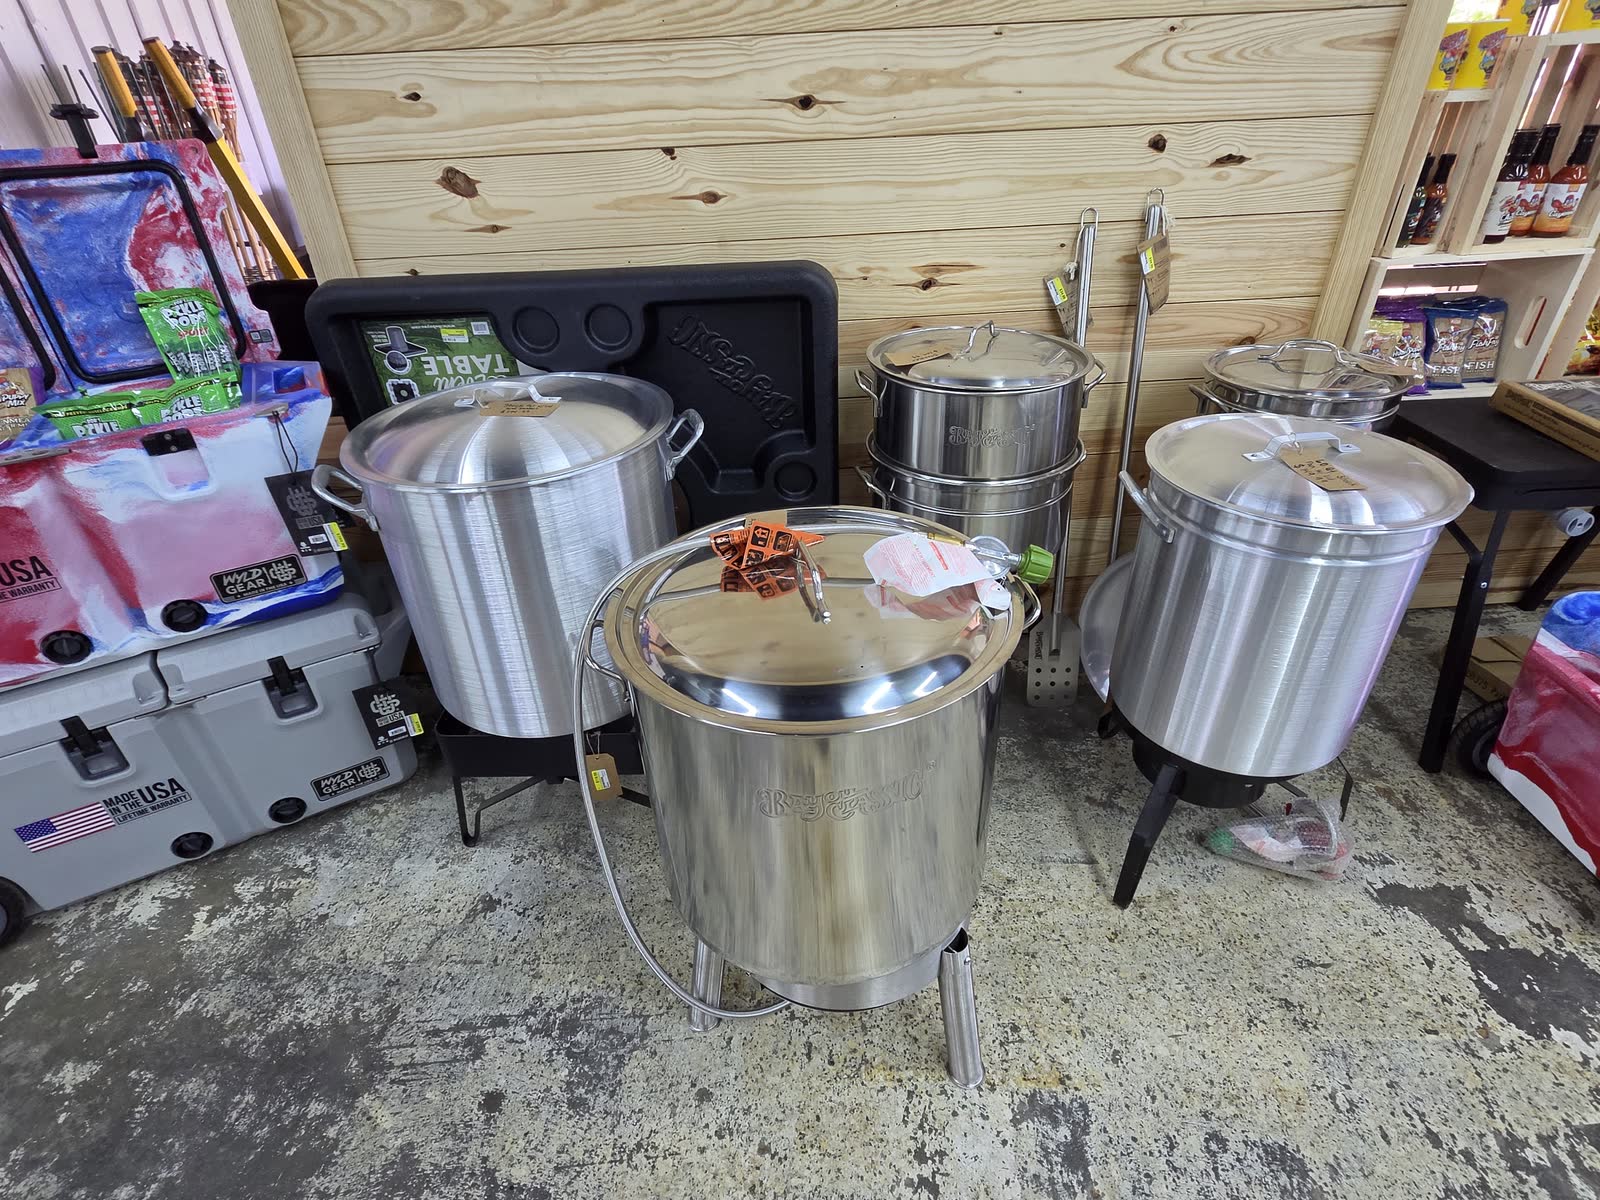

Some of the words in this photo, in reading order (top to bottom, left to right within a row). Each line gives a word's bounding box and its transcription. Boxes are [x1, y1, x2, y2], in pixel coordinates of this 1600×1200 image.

[177, 326, 209, 340] SPORT
[421, 353, 511, 376] TABLE
[1467, 361, 1495, 370] FISH
[2, 393, 31, 402] PUPPY
[7, 399, 26, 408] MIX
[0, 556, 53, 587] USA
[223, 568, 263, 587] WYLD
[8, 580, 56, 597] WARRANTY
[225, 578, 267, 595] GEAR
[321, 771, 353, 788] WYLD
[322, 778, 356, 794] GEAR
[103, 790, 138, 809] MADE
[137, 777, 187, 803] USA
[108, 807, 121, 816] IN
[123, 800, 143, 812] THE
[117, 809, 149, 824] LIFETIME
[150, 794, 189, 812] WARRANTY
